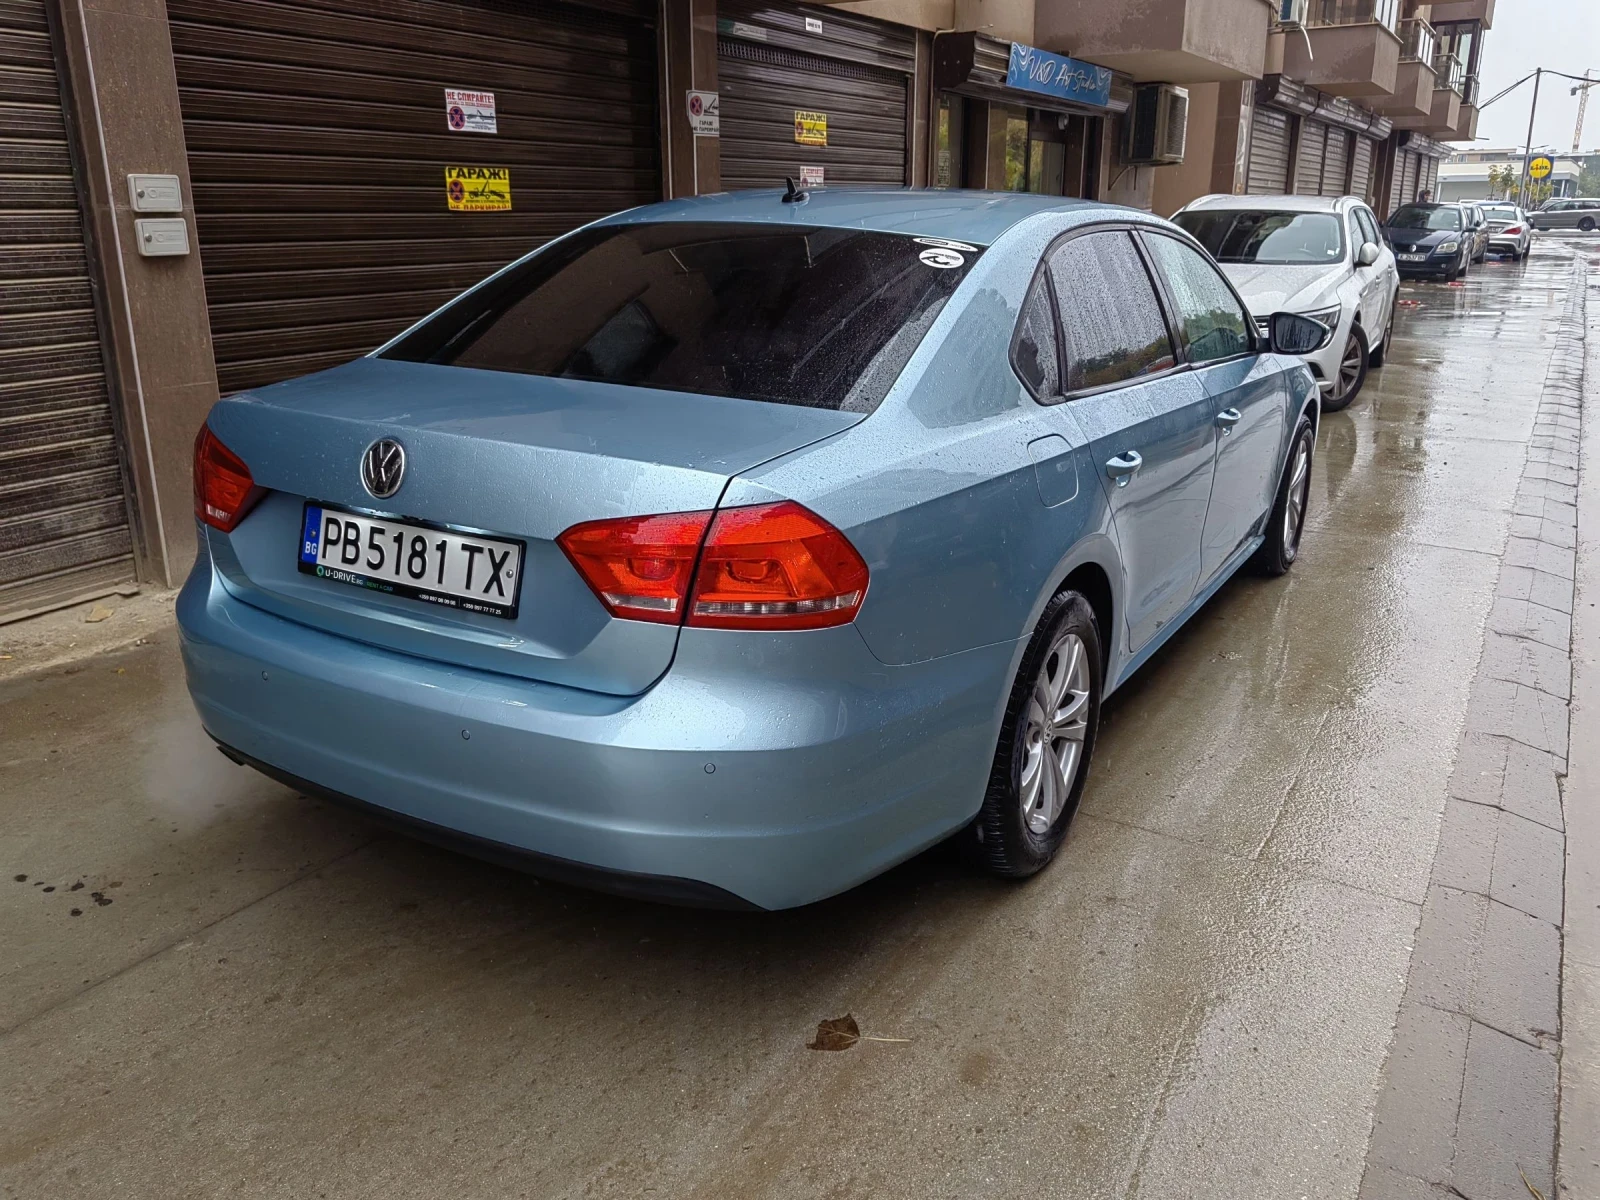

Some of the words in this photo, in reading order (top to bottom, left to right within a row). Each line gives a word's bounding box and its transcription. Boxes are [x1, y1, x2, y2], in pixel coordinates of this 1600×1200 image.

[446, 91, 456, 100] НЕ
[457, 92, 494, 104] СПИРАЙТЕ!
[447, 167, 507, 180] ГАРАЖ!
[304, 541, 317, 555] BG
